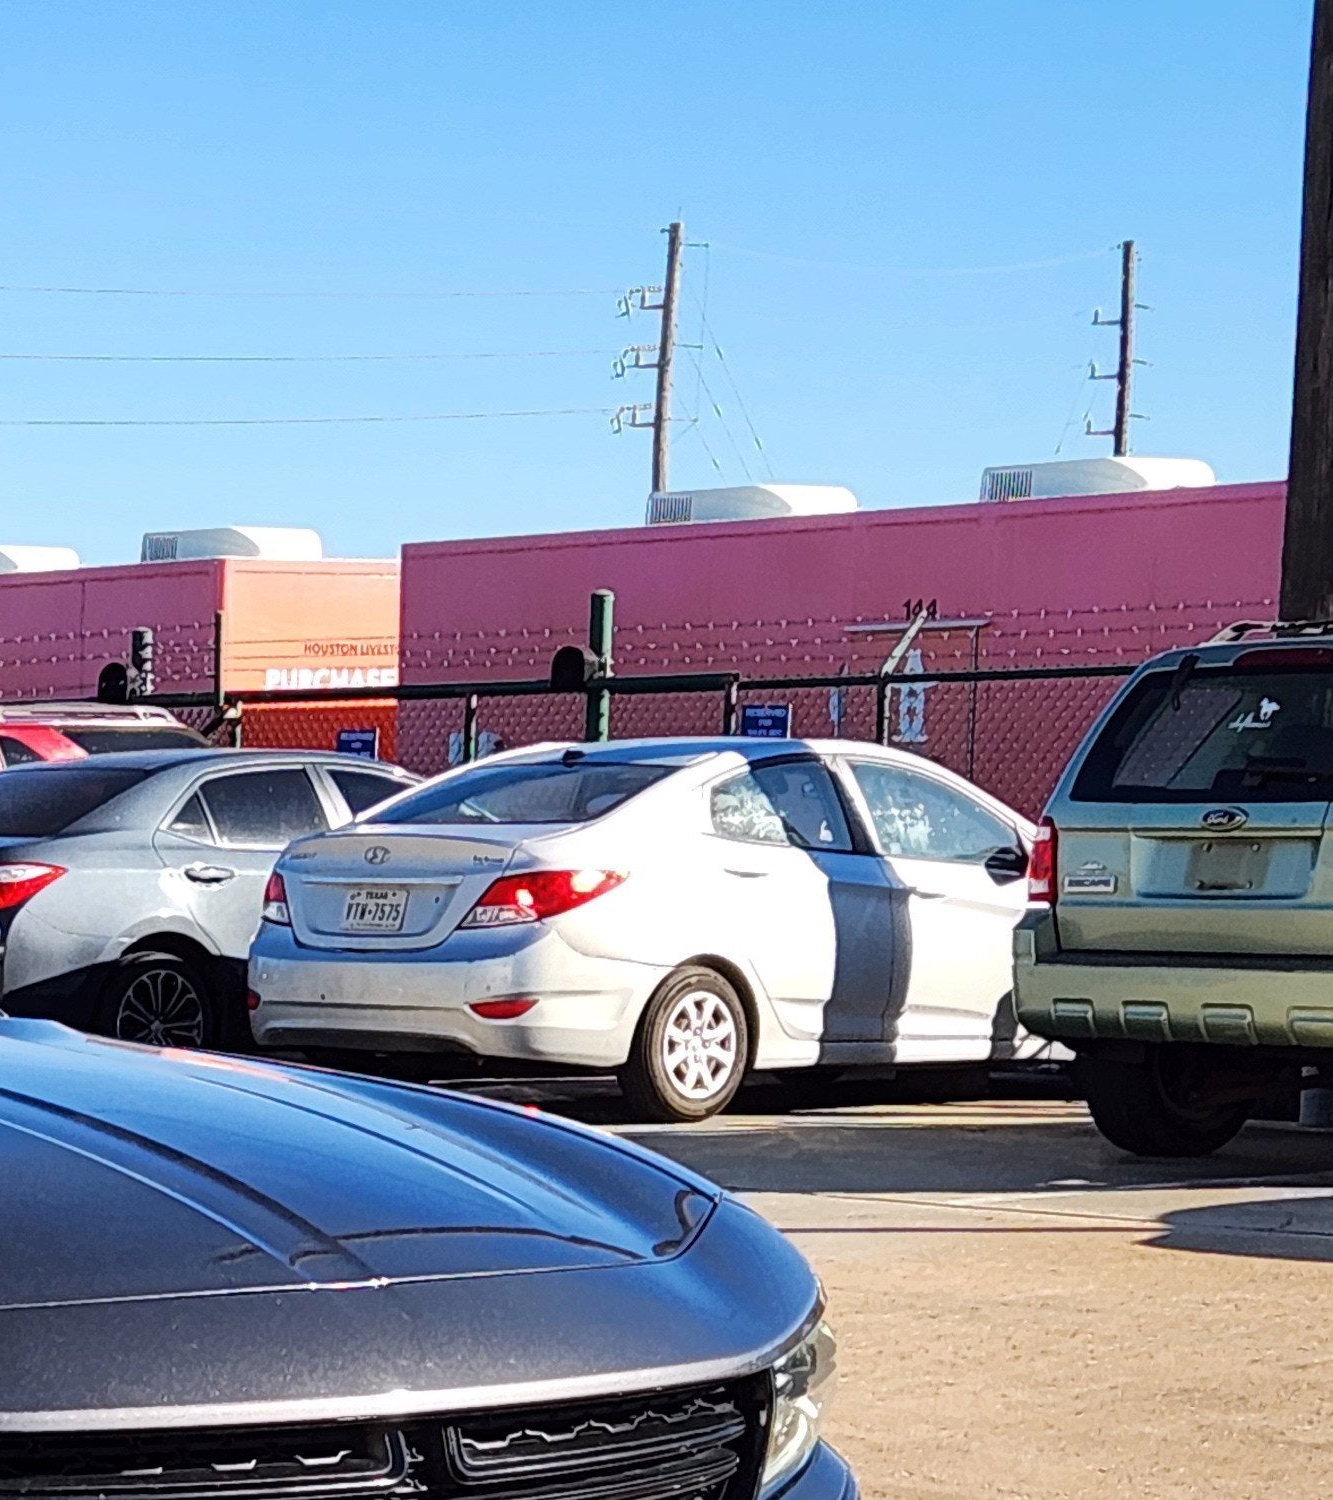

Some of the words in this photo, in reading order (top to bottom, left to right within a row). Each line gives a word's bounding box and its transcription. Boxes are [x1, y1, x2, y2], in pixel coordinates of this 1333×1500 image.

[902, 598, 937, 621] 144
[304, 643, 357, 656] HOUSTON
[264, 668, 397, 690] PURCHASE
[365, 890, 389, 901] TEXAS
